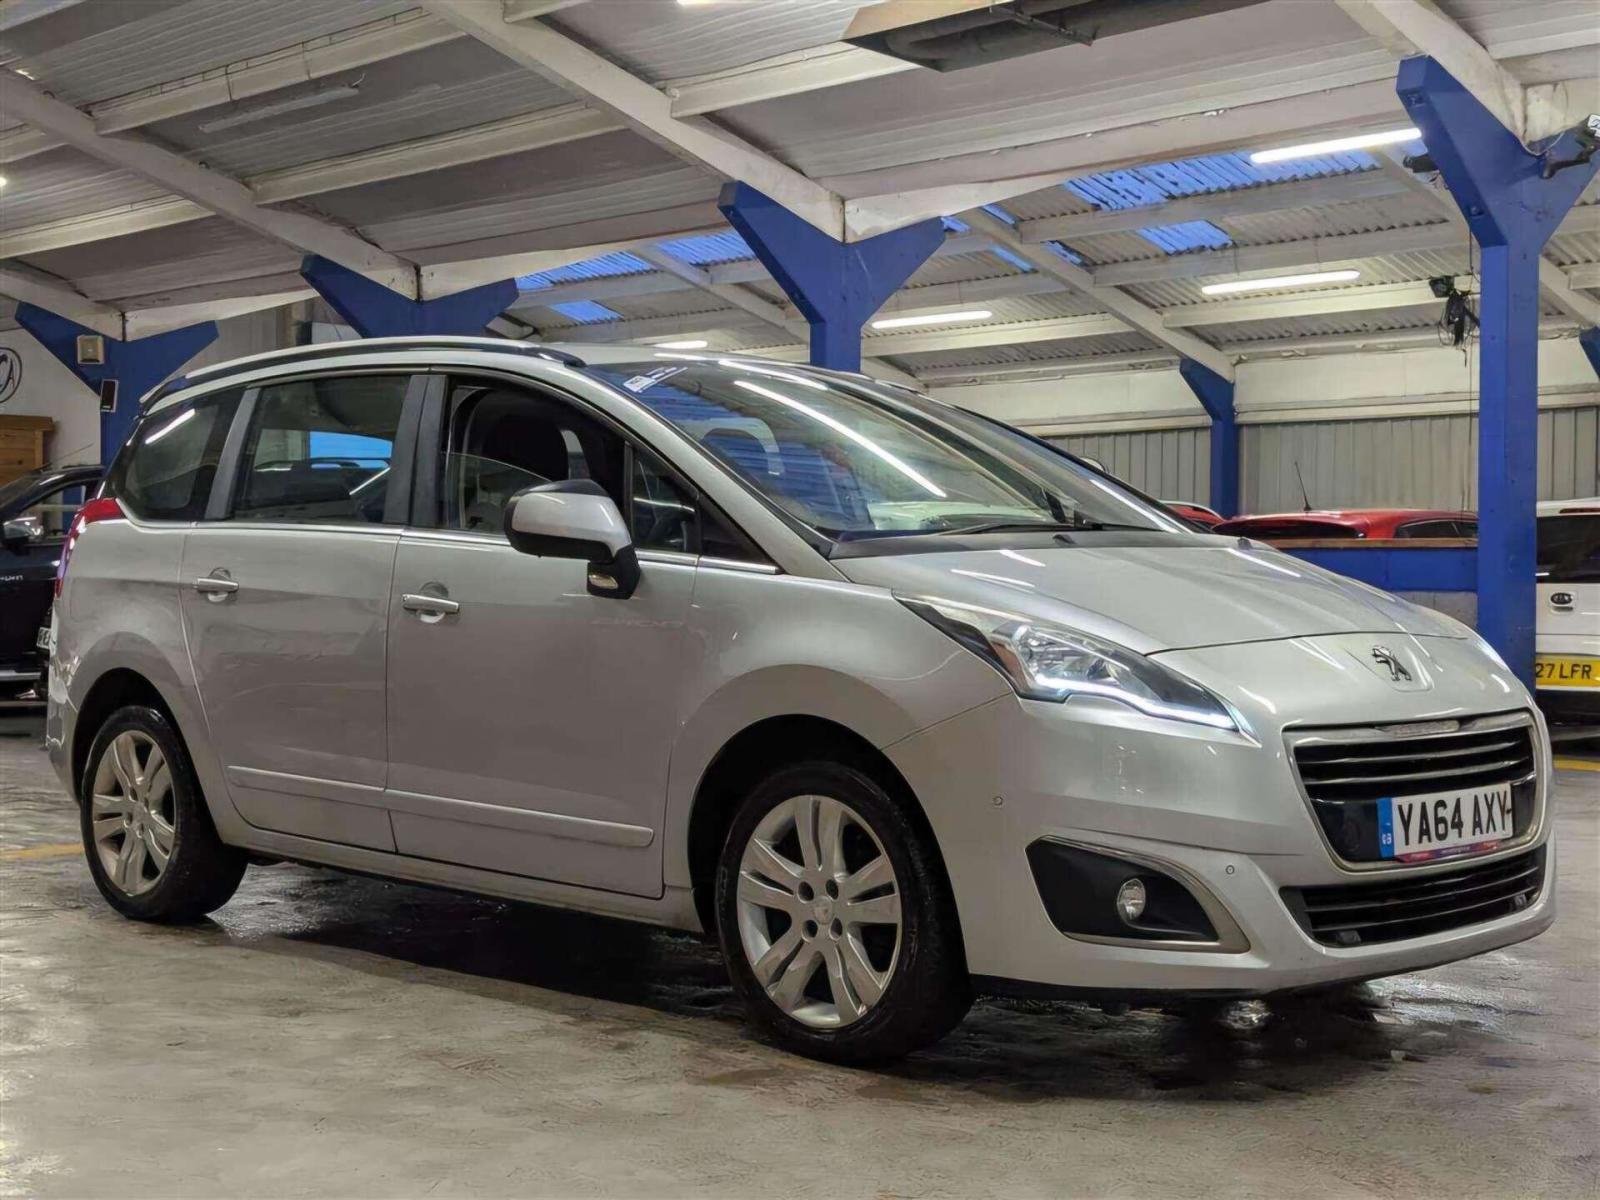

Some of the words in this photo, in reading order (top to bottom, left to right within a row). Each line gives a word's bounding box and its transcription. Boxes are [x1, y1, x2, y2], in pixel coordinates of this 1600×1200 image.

[1559, 663, 1592, 680] LFR
[1397, 797, 1464, 846] YA64
[1471, 790, 1508, 836] AXY
